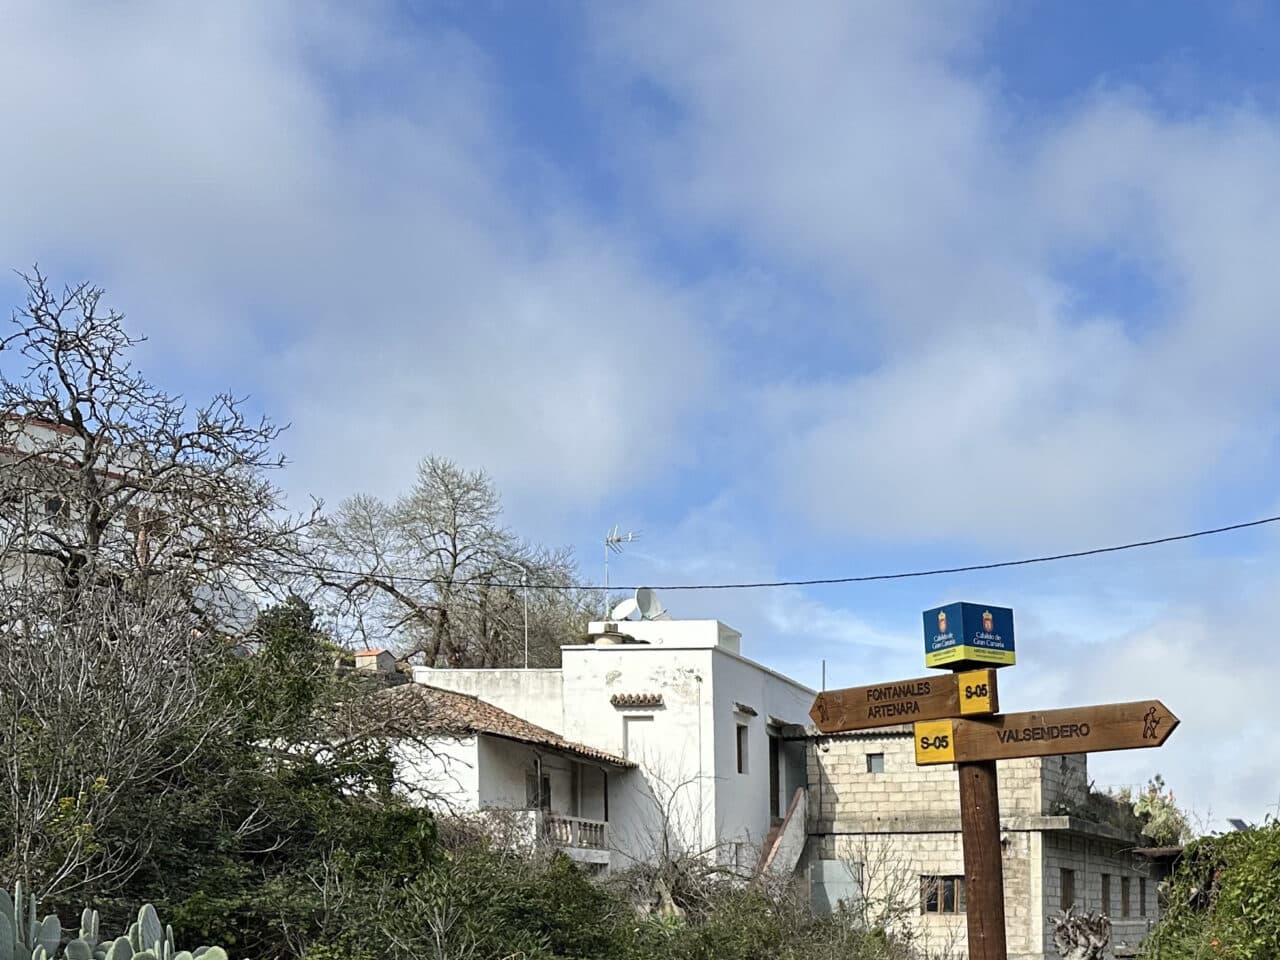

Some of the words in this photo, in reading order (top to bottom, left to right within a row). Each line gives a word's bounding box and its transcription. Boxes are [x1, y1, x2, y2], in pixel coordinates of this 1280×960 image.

[975, 631, 995, 640] Cabildo
[986, 640, 1004, 648] Canaria
[866, 681, 931, 702] FONTANALES
[965, 684, 988, 699] S-05
[867, 701, 920, 718] ARTENARA
[997, 723, 1091, 744] VALSENDERO
[920, 736, 949, 749] S-05
